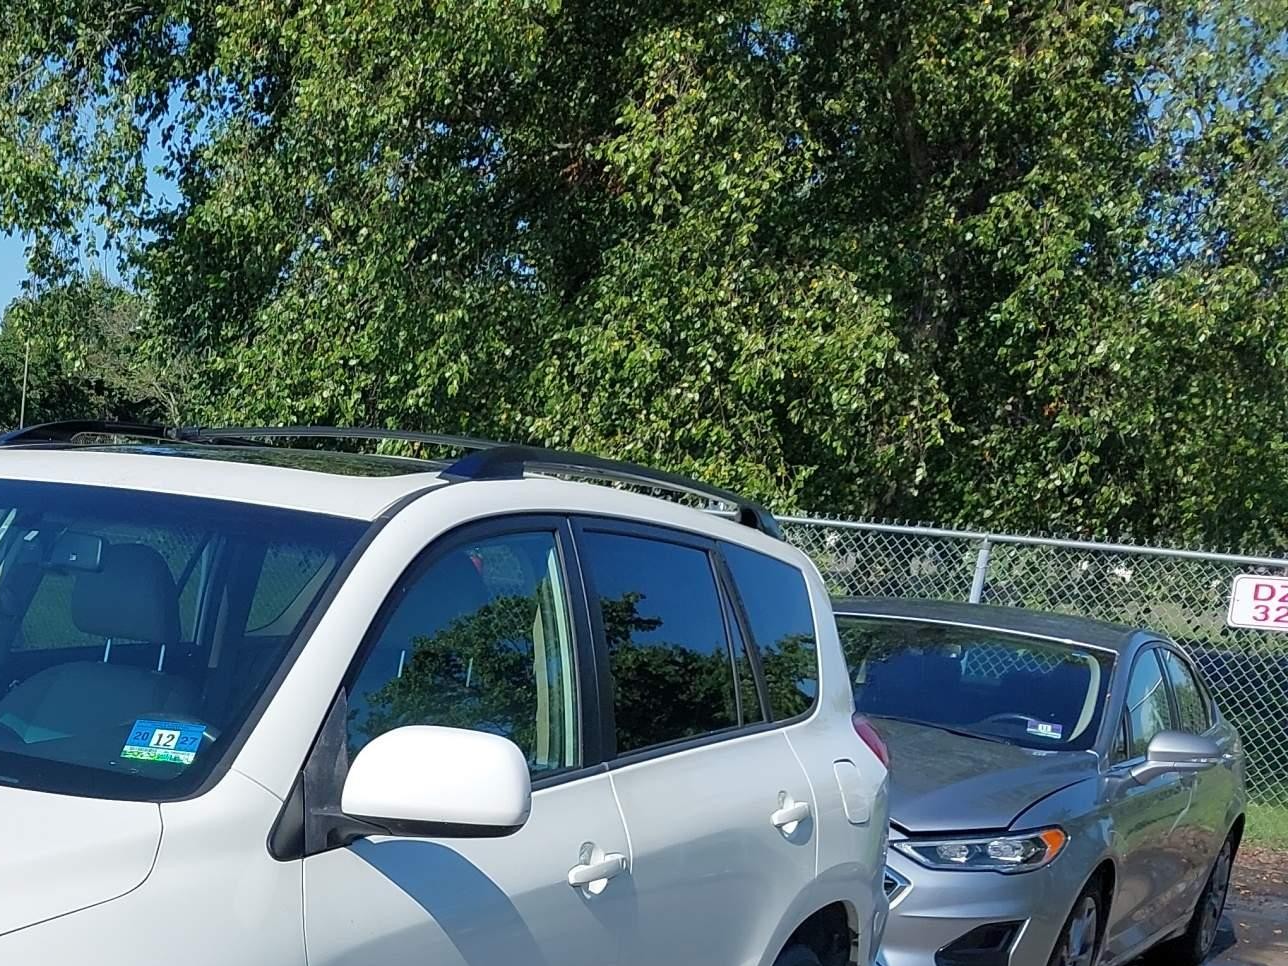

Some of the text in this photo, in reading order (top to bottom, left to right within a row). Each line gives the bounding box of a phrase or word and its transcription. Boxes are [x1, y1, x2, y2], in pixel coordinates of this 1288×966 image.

[1252, 604, 1288, 623] 32
[133, 731, 198, 747] 20 12 27
